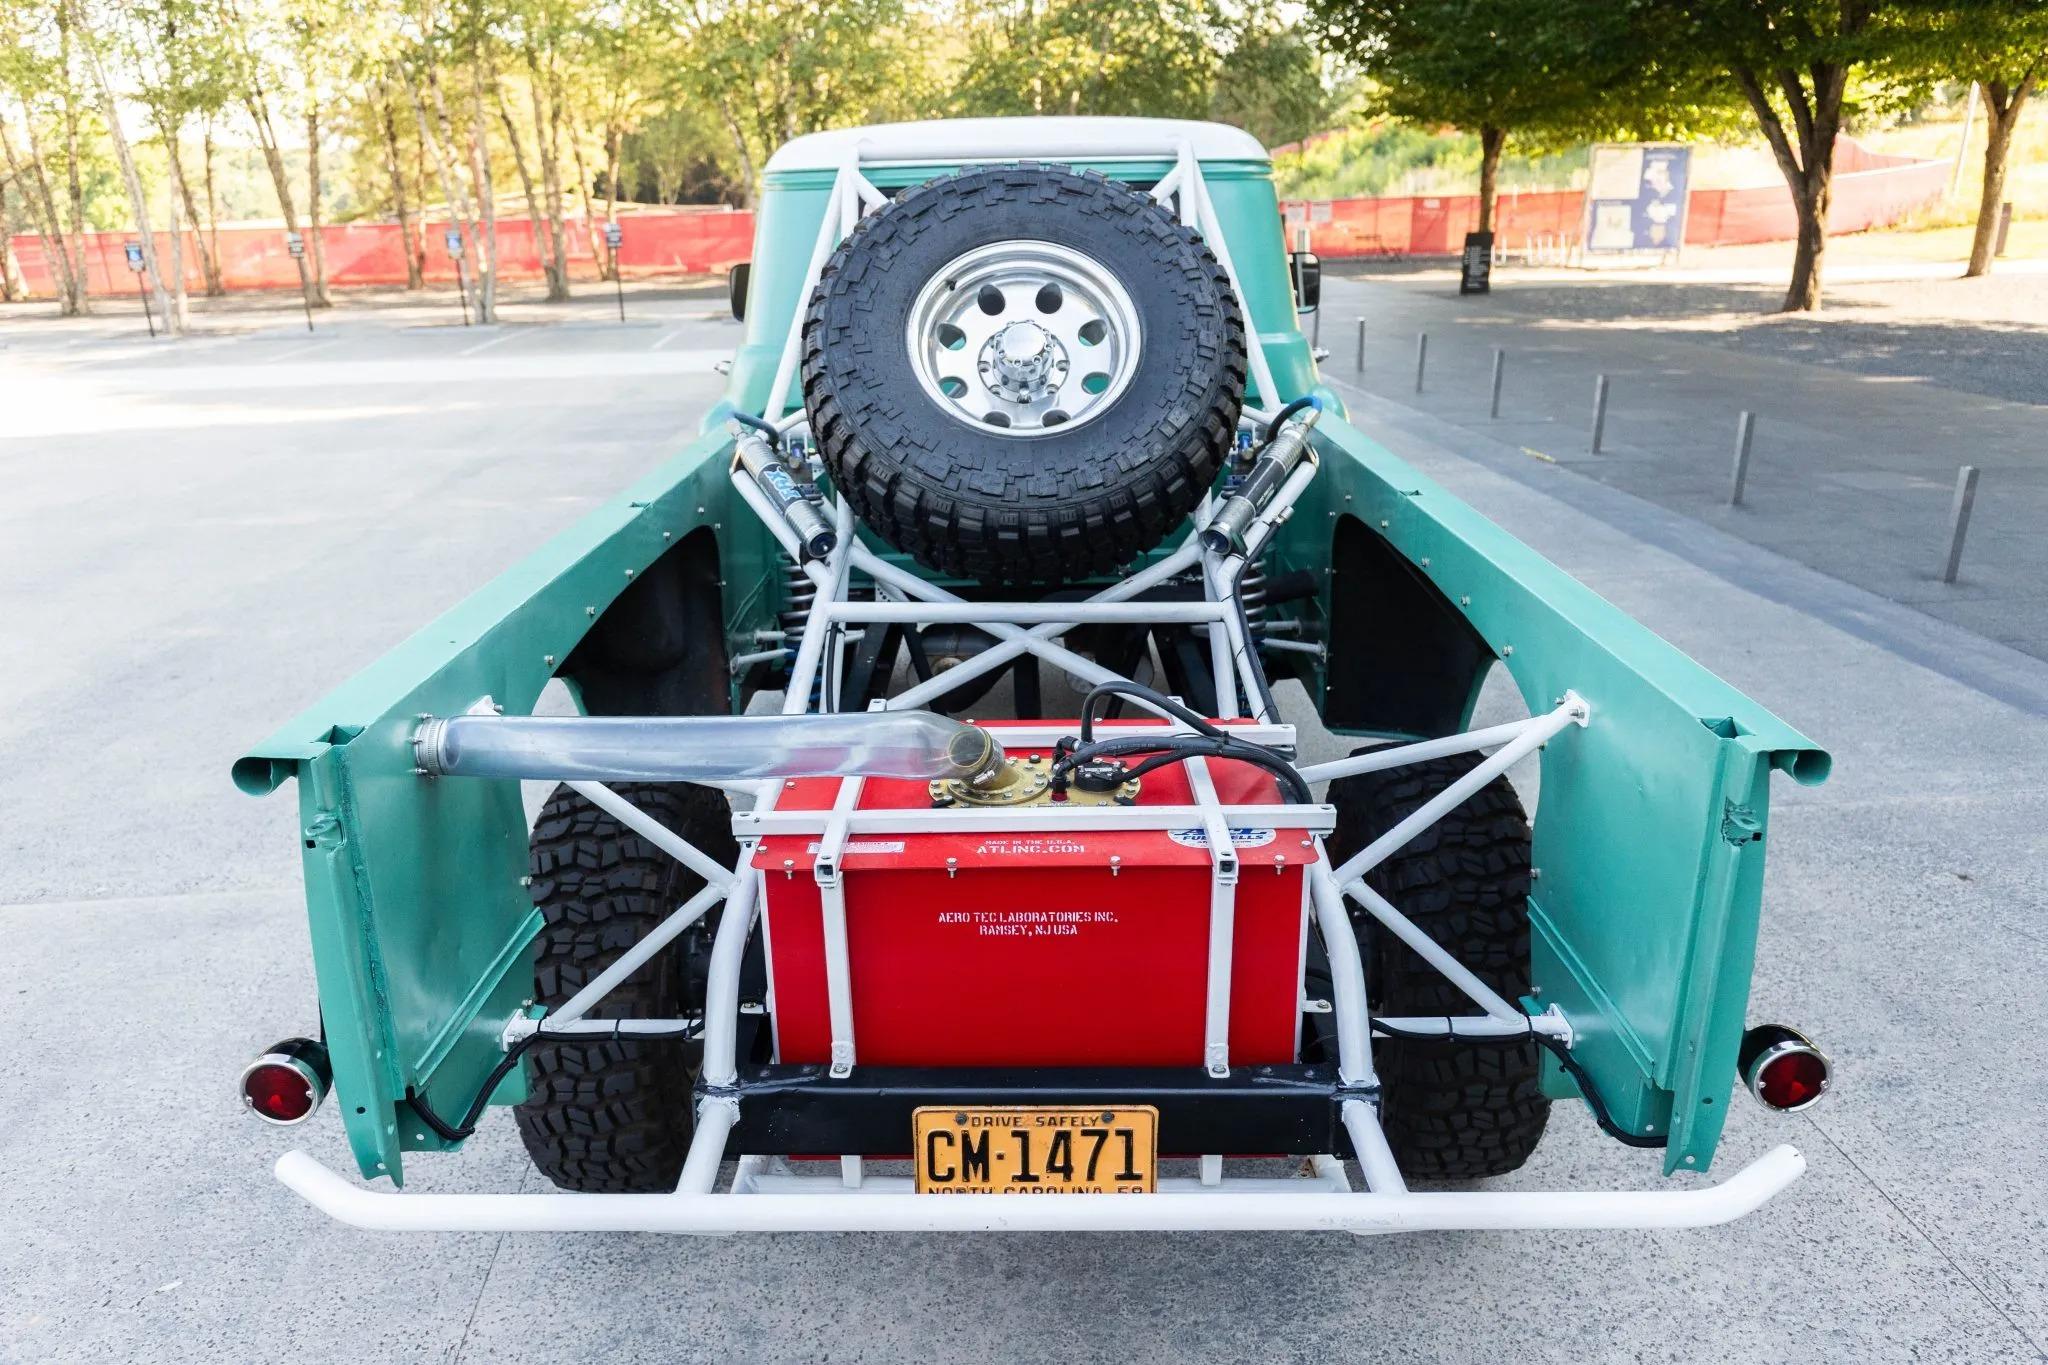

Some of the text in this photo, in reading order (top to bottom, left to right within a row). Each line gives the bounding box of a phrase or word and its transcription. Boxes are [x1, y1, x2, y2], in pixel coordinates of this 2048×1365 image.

[938, 911, 1119, 923] AERO TEC LABORATORIES INC.
[979, 924, 1078, 937] RAMSEY, NJ USA
[971, 1116, 1099, 1127] DRIVE SAFELY
